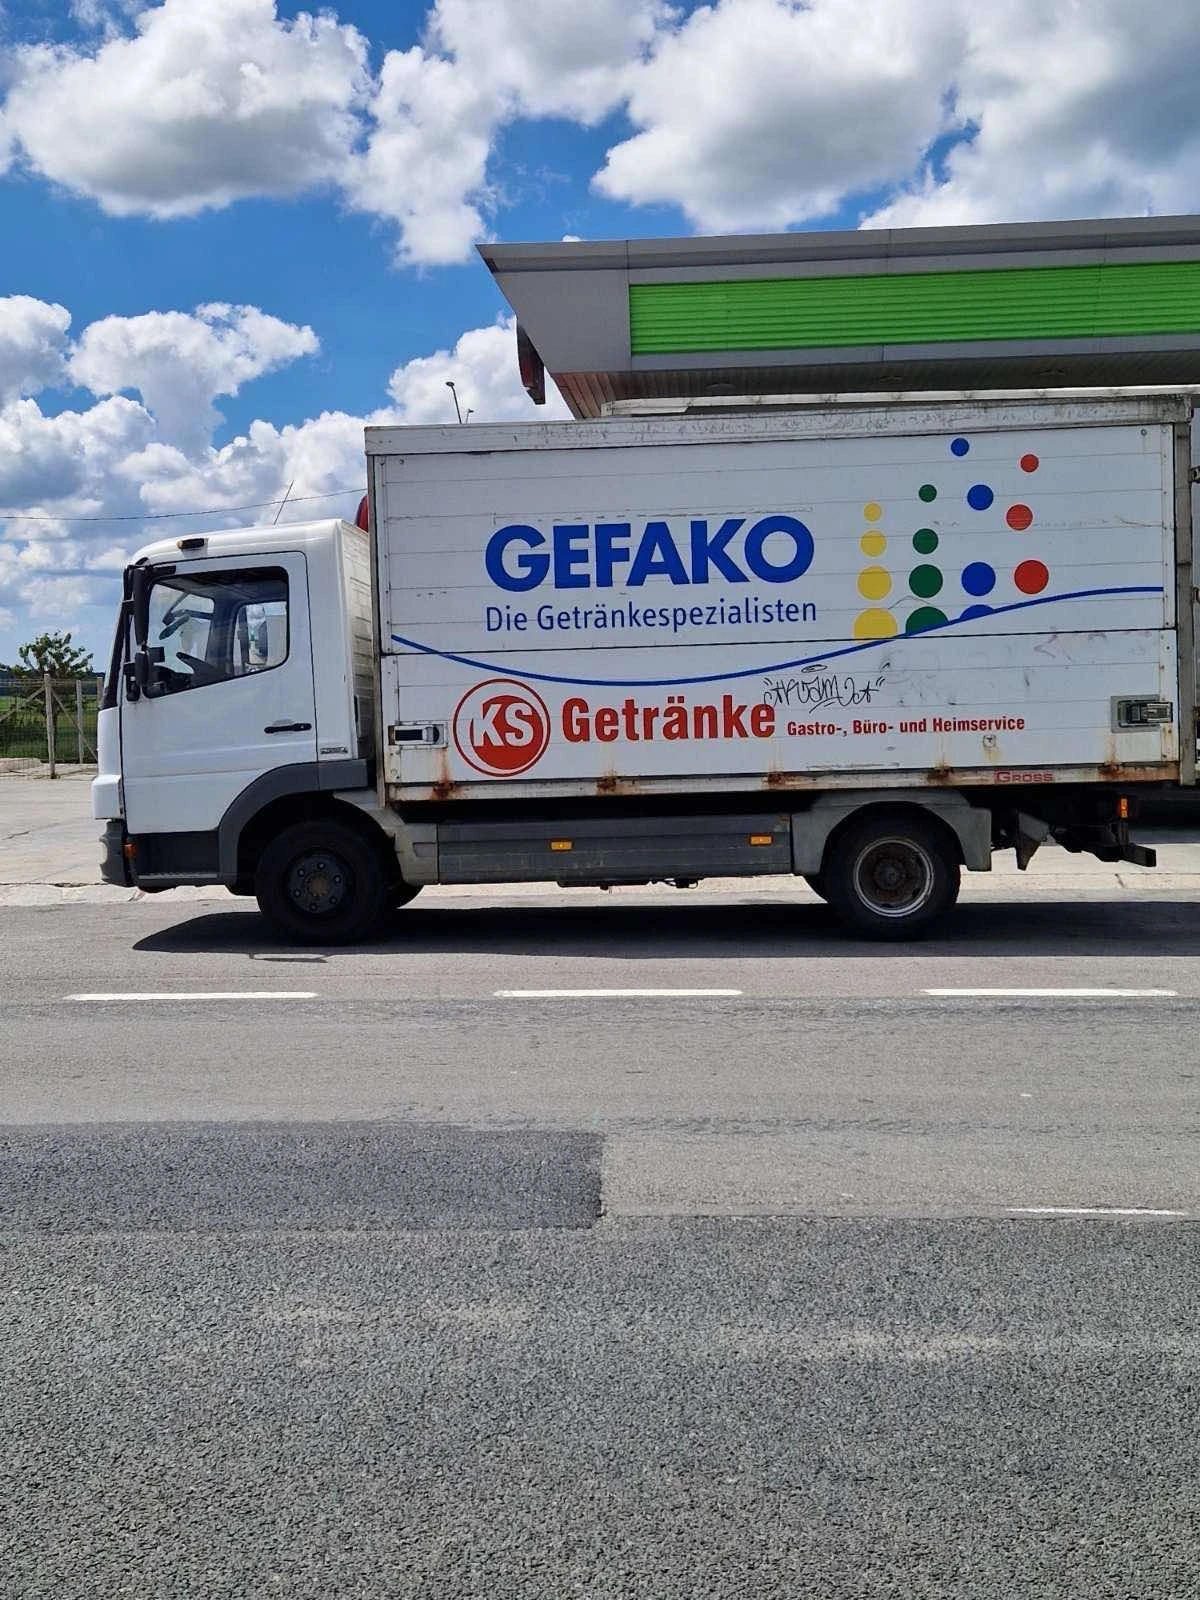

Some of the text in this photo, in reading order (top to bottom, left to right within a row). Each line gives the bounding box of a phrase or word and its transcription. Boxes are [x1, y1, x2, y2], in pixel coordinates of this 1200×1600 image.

[484, 515, 815, 592] GEFAKO
[486, 598, 817, 632] Die Getränkespezialisten
[473, 695, 775, 747] KS Getränke
[787, 715, 1025, 737] Gastro-, Büro- und Heimservice
[996, 771, 1053, 784] GROSS
